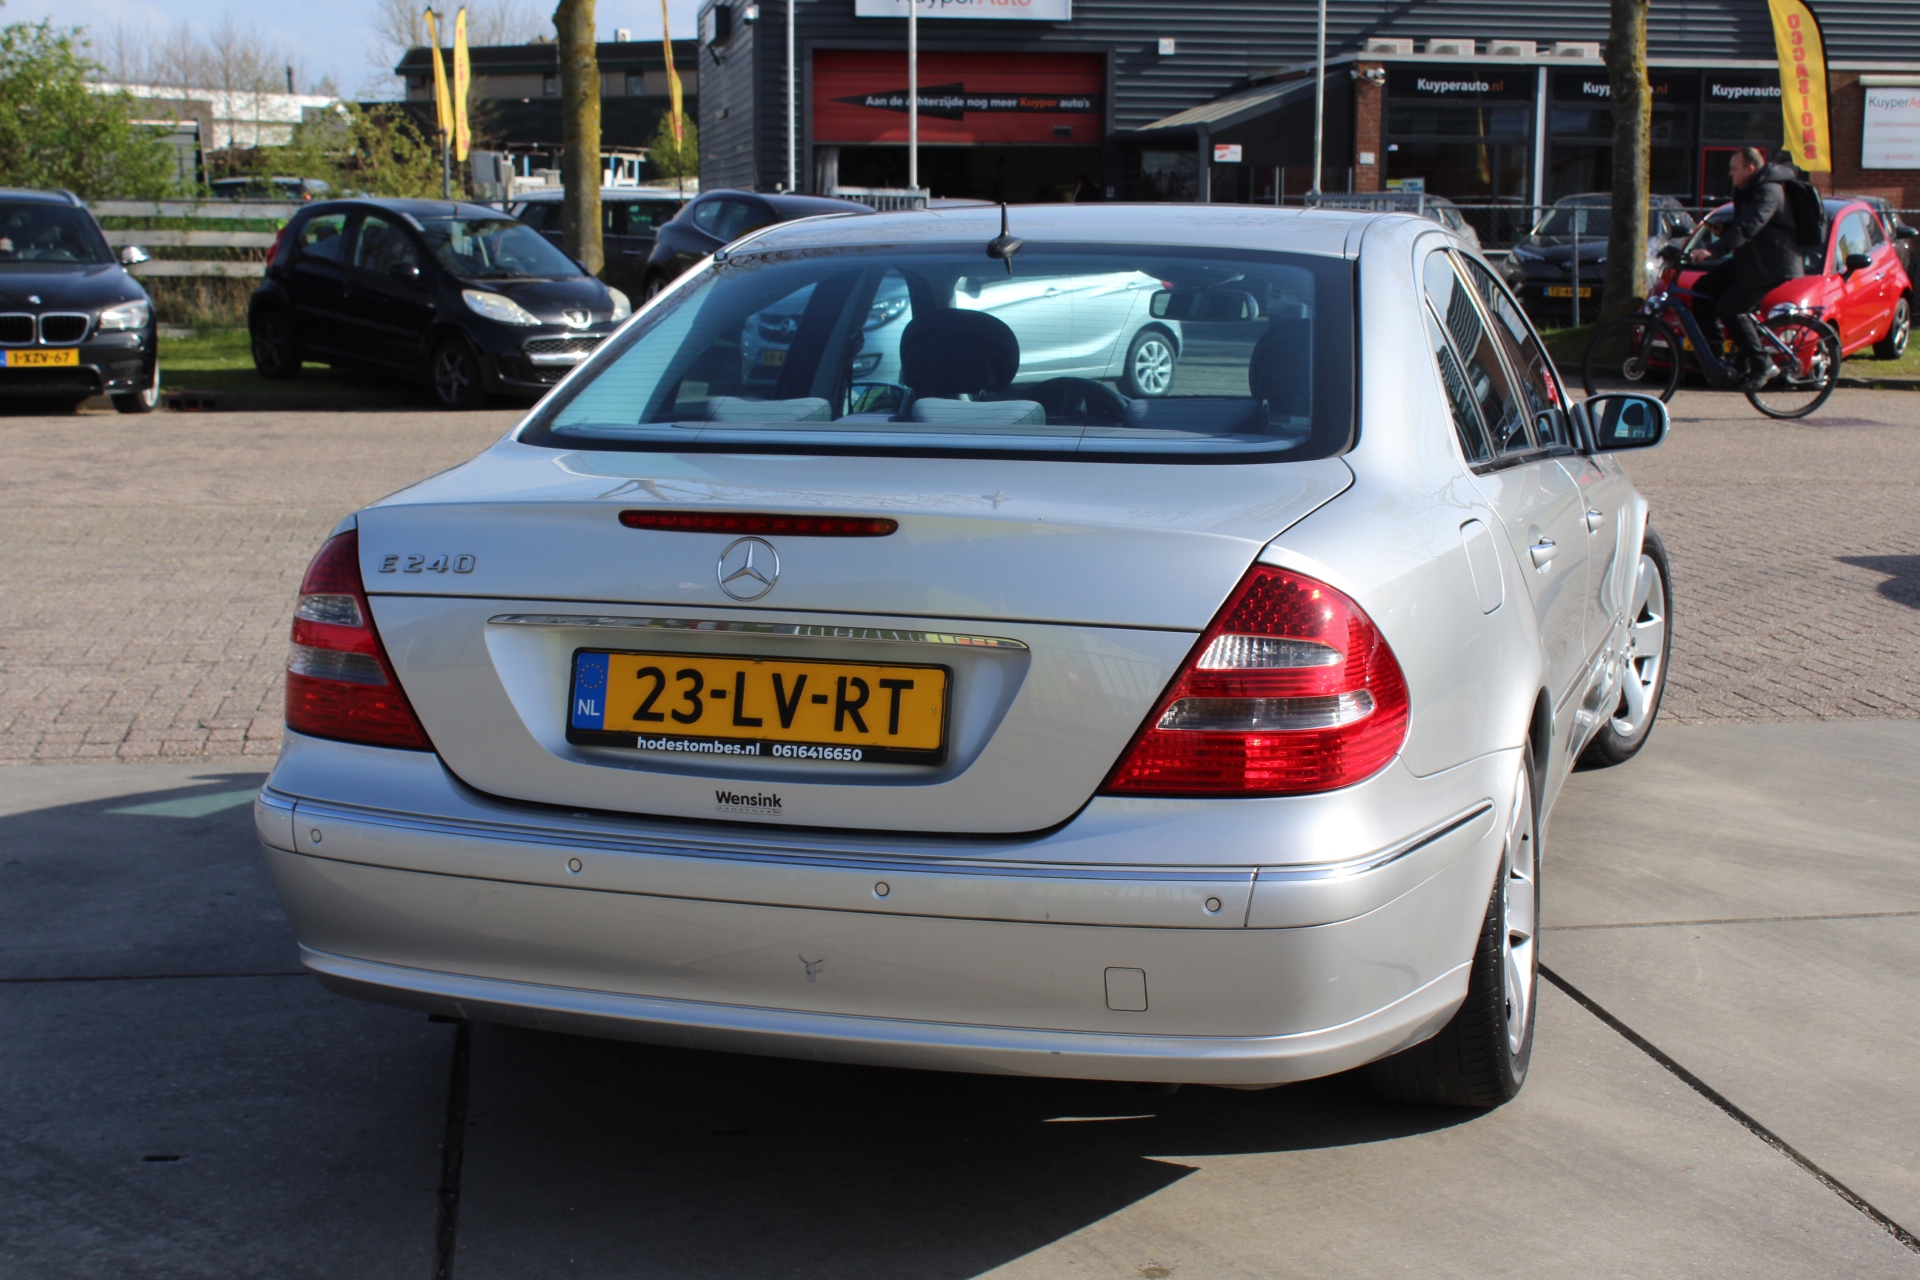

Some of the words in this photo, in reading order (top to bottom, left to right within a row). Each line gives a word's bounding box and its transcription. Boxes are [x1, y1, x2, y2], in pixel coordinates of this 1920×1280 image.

[1417, 79, 1504, 94] Kuyperauto.nl
[865, 96, 887, 106] Aan
[889, 96, 903, 107] de
[905, 96, 965, 110] ahterzijde
[967, 99, 988, 110] nog
[990, 99, 1018, 108] meer
[1020, 98, 1058, 110] Kuyper
[1060, 99, 1091, 109] auto's
[378, 554, 400, 573] E
[403, 554, 476, 574] 240
[577, 699, 600, 716] NL
[632, 666, 915, 736] 23-LV-RT
[637, 736, 760, 756] hodestombes.nl
[772, 744, 863, 762] 0616416650
[715, 790, 782, 808] Wensink
